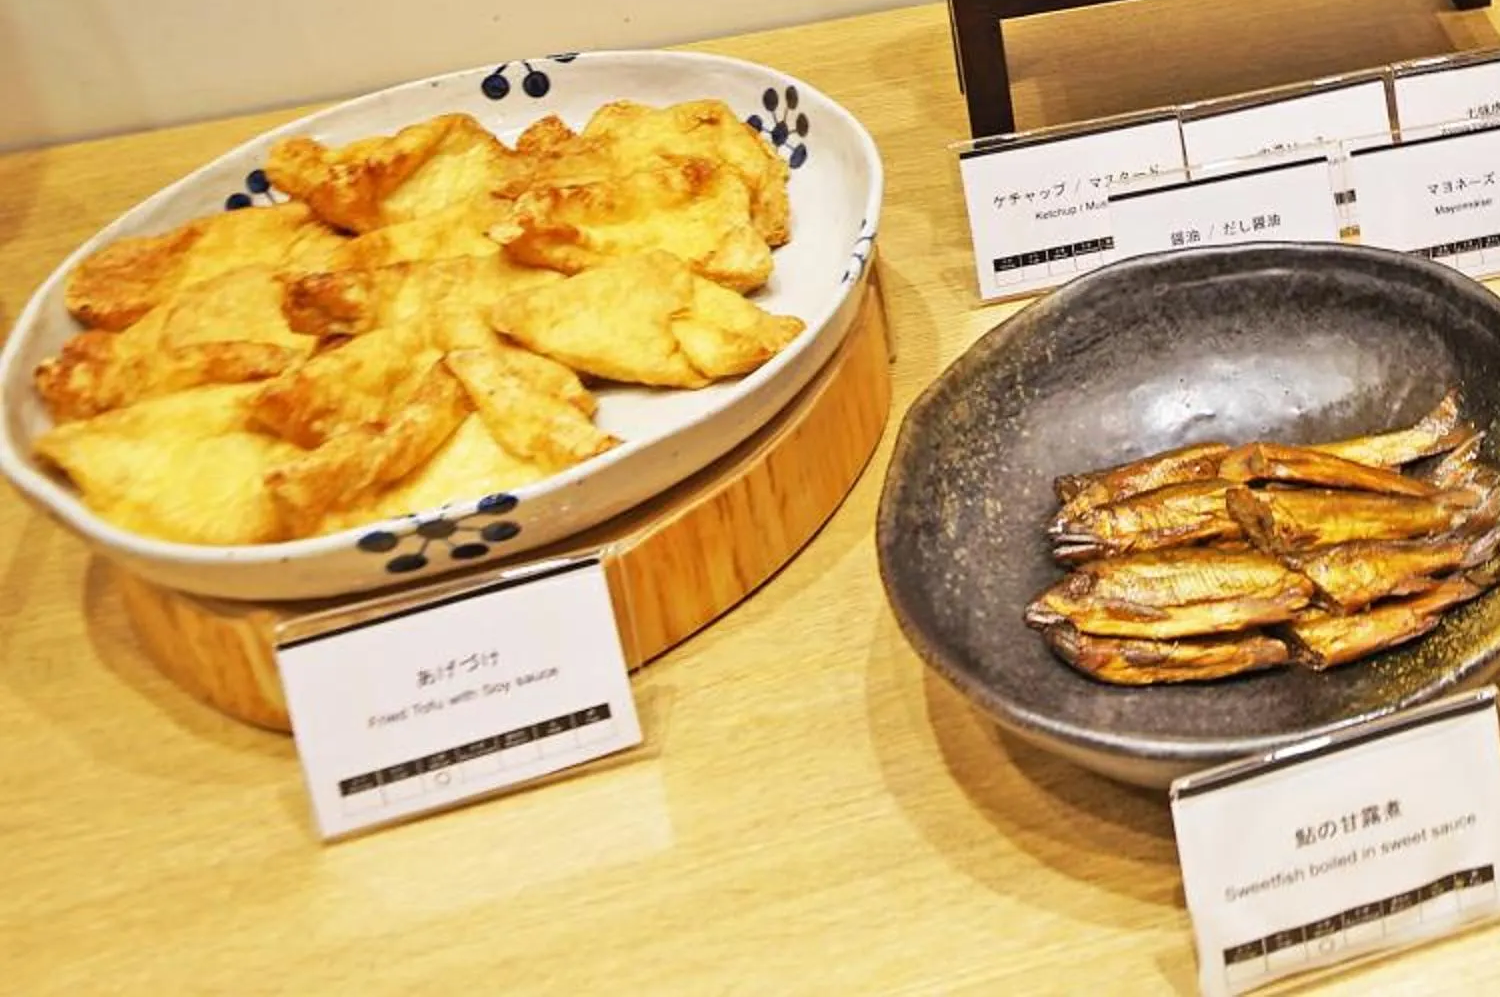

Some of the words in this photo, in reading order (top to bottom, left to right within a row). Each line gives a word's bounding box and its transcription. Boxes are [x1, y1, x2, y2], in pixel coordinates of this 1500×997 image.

[994, 181, 1066, 211] ケチャップ
[1427, 170, 1496, 195] マヨネーズ
[1171, 229, 1201, 247] 醤油
[1223, 213, 1282, 236] だし醤油
[1294, 799, 1404, 849] 鮎の甘露煮
[1225, 868, 1306, 903] Sweetfish
[1310, 850, 1357, 877] boiled
[1360, 845, 1378, 861] in
[1382, 829, 1428, 854] sweet
[1431, 811, 1477, 839] sauce
